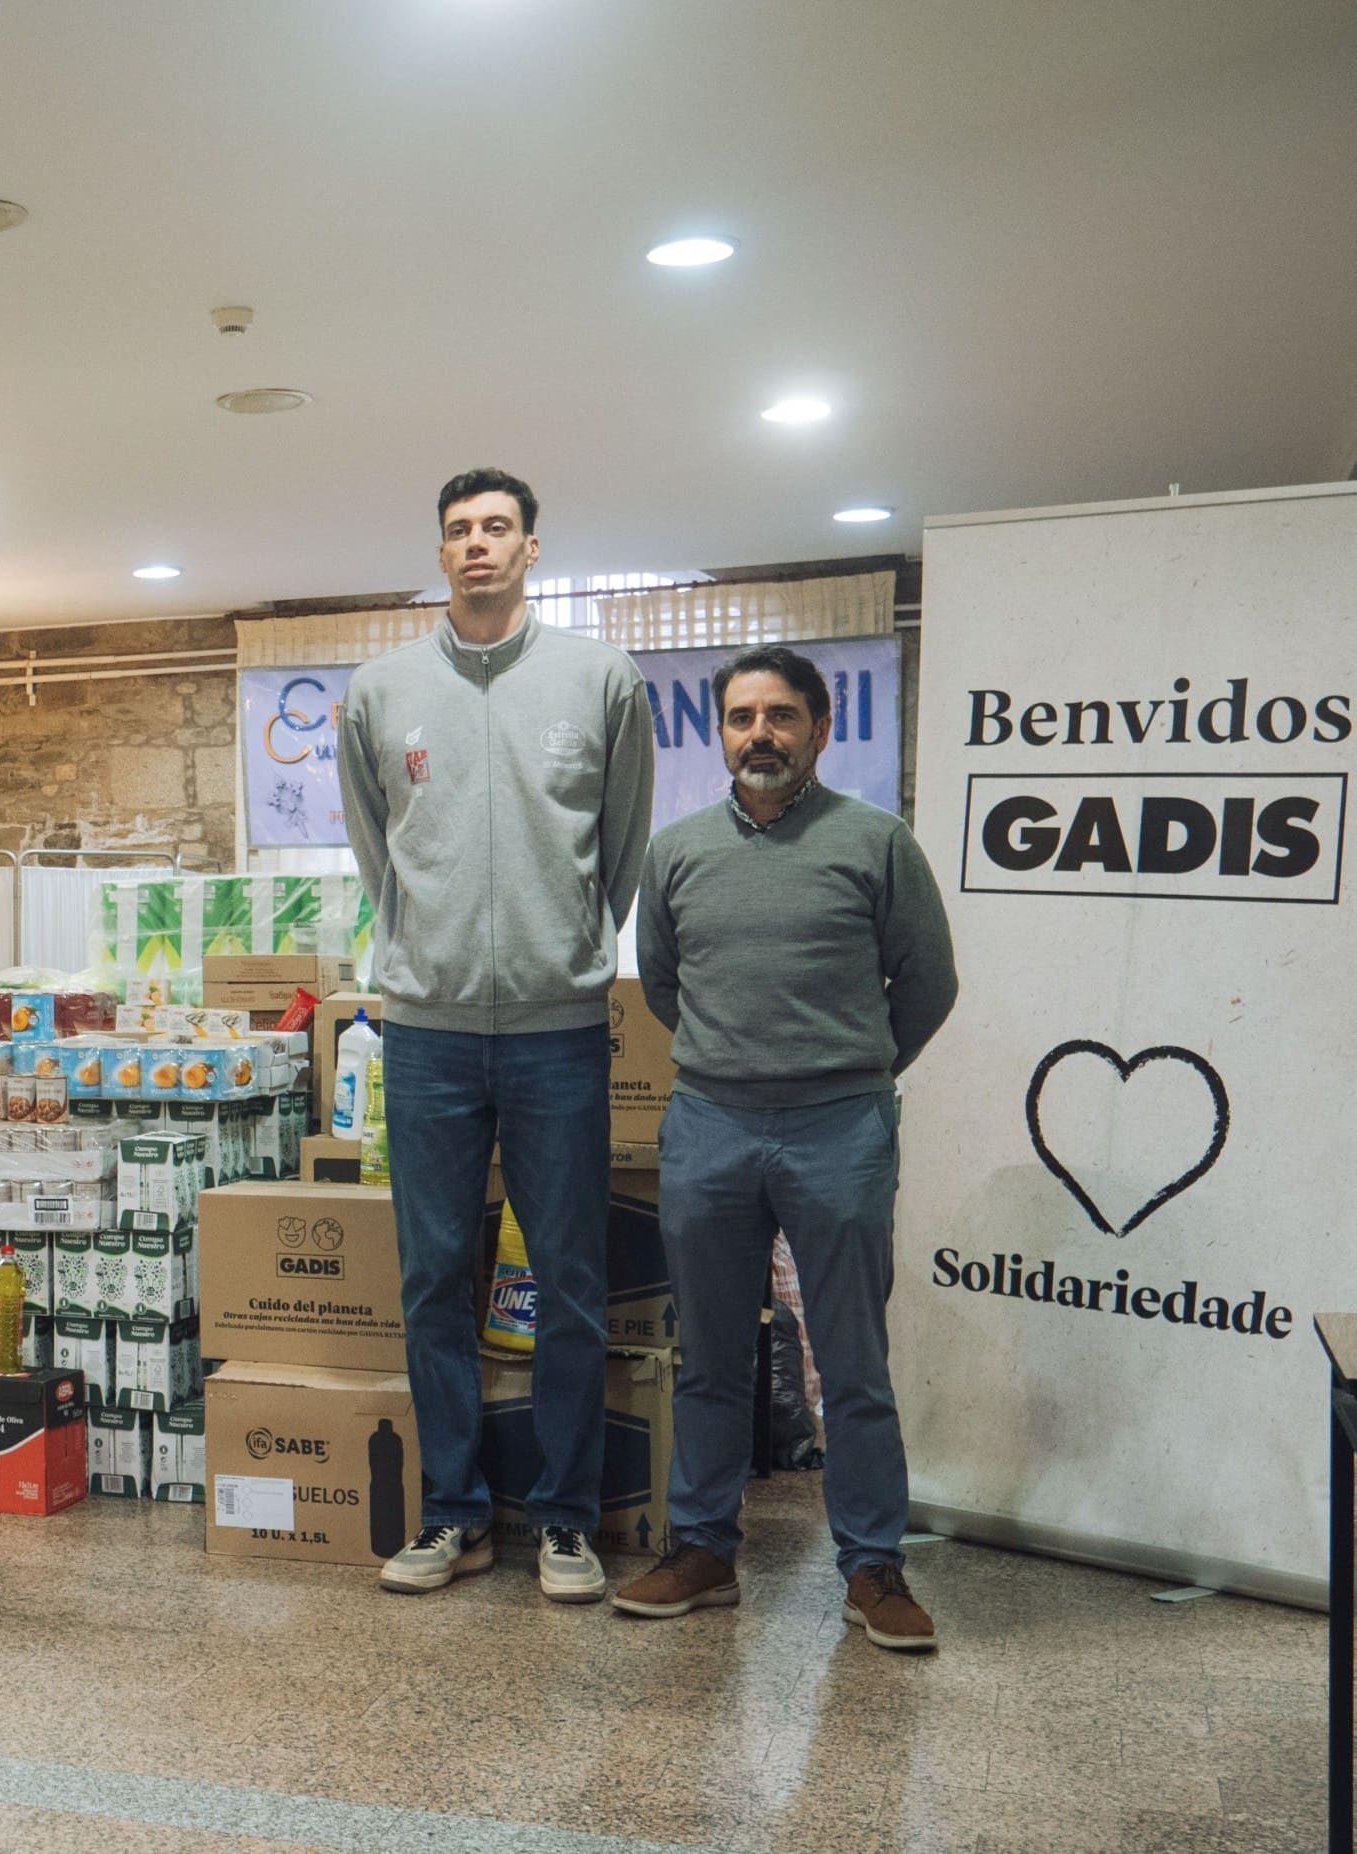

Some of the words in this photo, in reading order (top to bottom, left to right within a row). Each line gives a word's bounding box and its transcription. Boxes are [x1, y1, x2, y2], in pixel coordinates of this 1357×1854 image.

[965, 677, 1352, 747] Benvidos
[982, 796, 1320, 877] GADIS
[610, 1079, 652, 1091] aneta
[134, 1145, 159, 1153] Campo
[133, 1150, 160, 1158] Nuestro
[60, 1237, 87, 1245] Nuestro
[99, 1233, 125, 1242] Campo
[138, 1235, 164, 1244] Campo
[98, 1239, 126, 1248] Nuestro
[137, 1241, 165, 1250] Nuestro
[279, 1257, 340, 1276] GADIS
[932, 1247, 1293, 1339] Solidariedade
[249, 1297, 291, 1311] Cuido
[293, 1299, 315, 1313] del
[318, 1301, 373, 1317] planeta
[223, 1311, 248, 1320] Otras
[249, 1313, 273, 1323] cajas
[273, 1313, 320, 1325] recicladas
[321, 1317, 335, 1325] me
[335, 1317, 354, 1327] han
[355, 1318, 379, 1328] dado
[380, 1320, 401, 1329] vida
[67, 1321, 89, 1330] Campo
[132, 1325, 155, 1333] Campo
[624, 1320, 655, 1336] PIE
[65, 1326, 89, 1335] Nuestro
[131, 1330, 156, 1338] Nuestro
[100, 1411, 123, 1420] Campo
[169, 1415, 193, 1424] Campo
[7, 1416, 24, 1425] Oliva
[99, 1416, 123, 1426] Nuestro
[168, 1421, 194, 1430] Nuestro
[252, 1437, 268, 1450] ifa
[275, 1437, 326, 1456] SABE
[293, 1486, 360, 1505] UELOS
[251, 1528, 268, 1539] 10
[271, 1530, 286, 1541] U.
[289, 1531, 297, 1541] x
[300, 1531, 331, 1544] 1,5L
